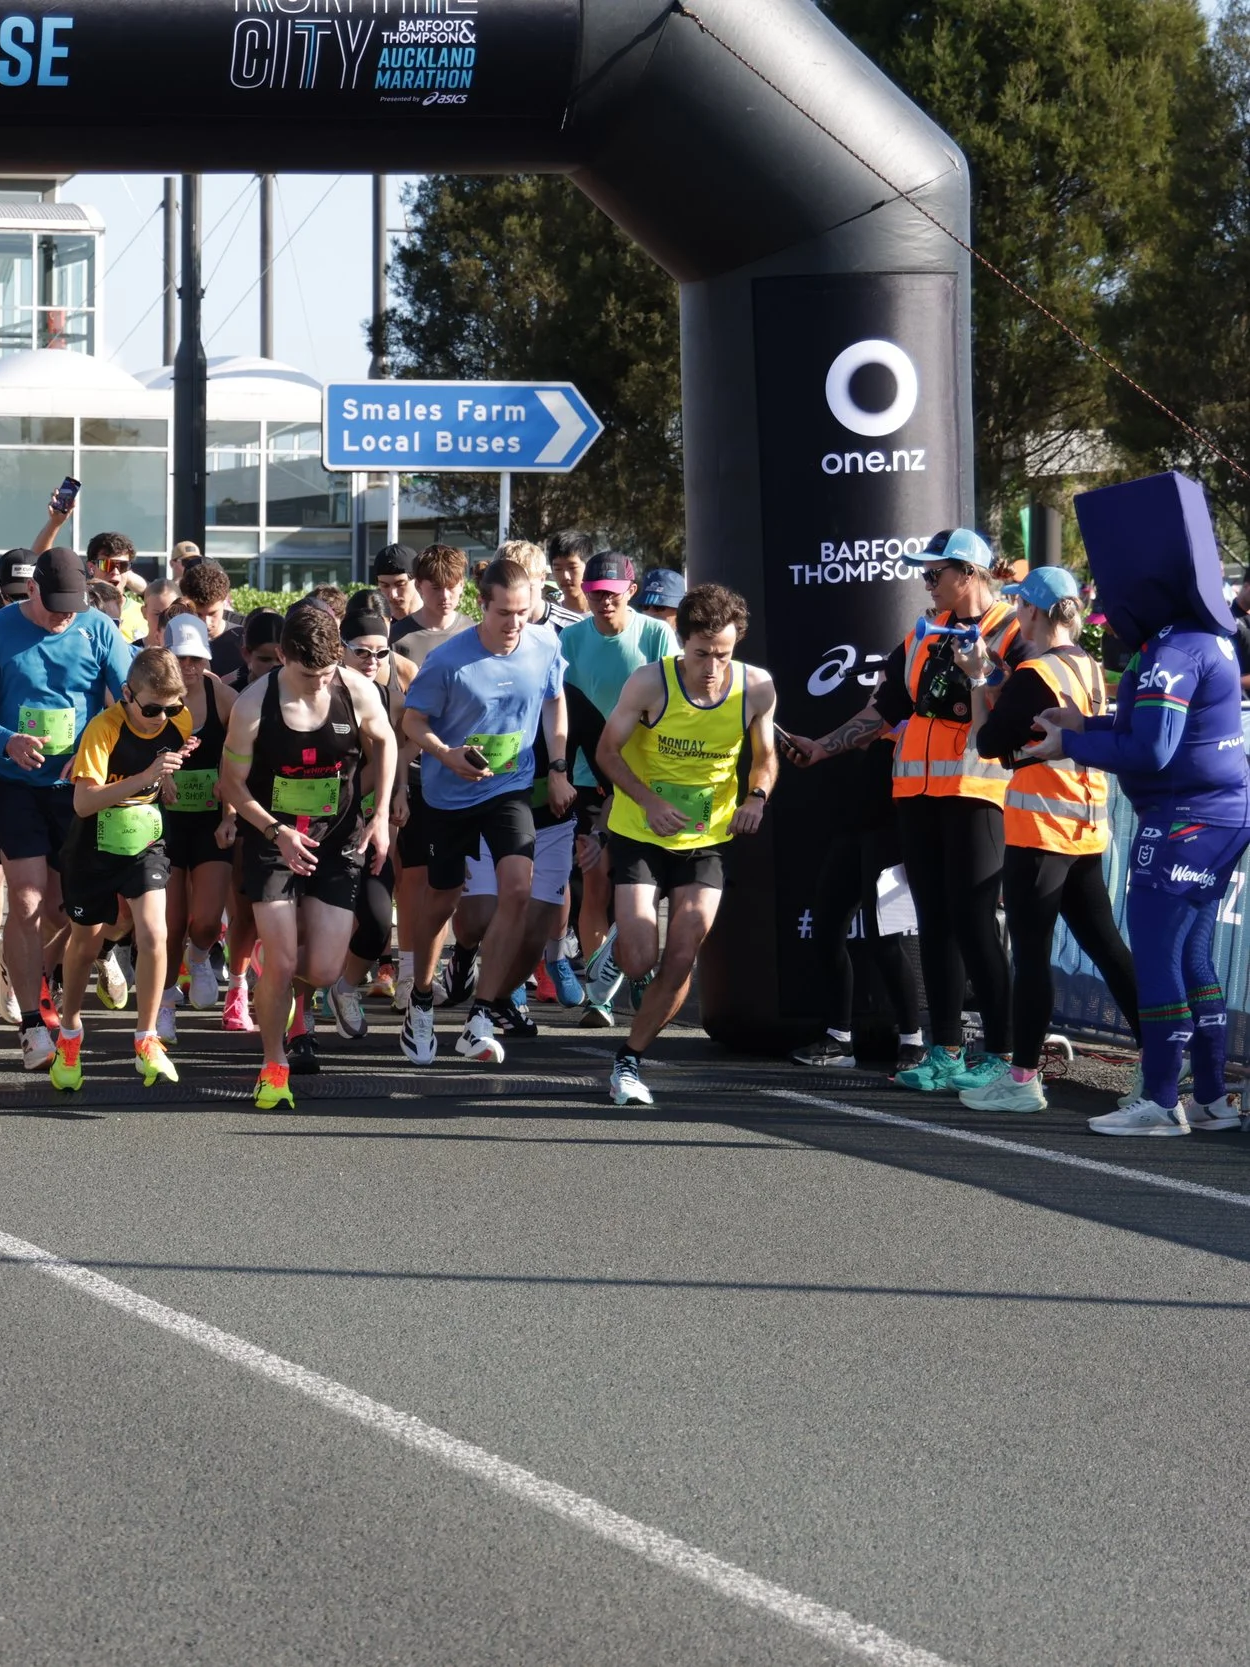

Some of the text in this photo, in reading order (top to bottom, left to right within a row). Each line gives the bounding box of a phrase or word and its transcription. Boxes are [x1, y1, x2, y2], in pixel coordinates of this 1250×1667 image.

[399, 20, 460, 32] BARFOOT
[381, 32, 459, 44] THOMPSON
[230, 18, 375, 90] CITY
[377, 48, 476, 69] AUCKLAND
[374, 70, 472, 90] MARATHON
[342, 399, 526, 422] Smales Farm
[343, 430, 521, 453] Local Buses
[821, 449, 926, 475] one.nz
[657, 734, 706, 752] MONDAY
[1169, 863, 1217, 890] Wendy's
